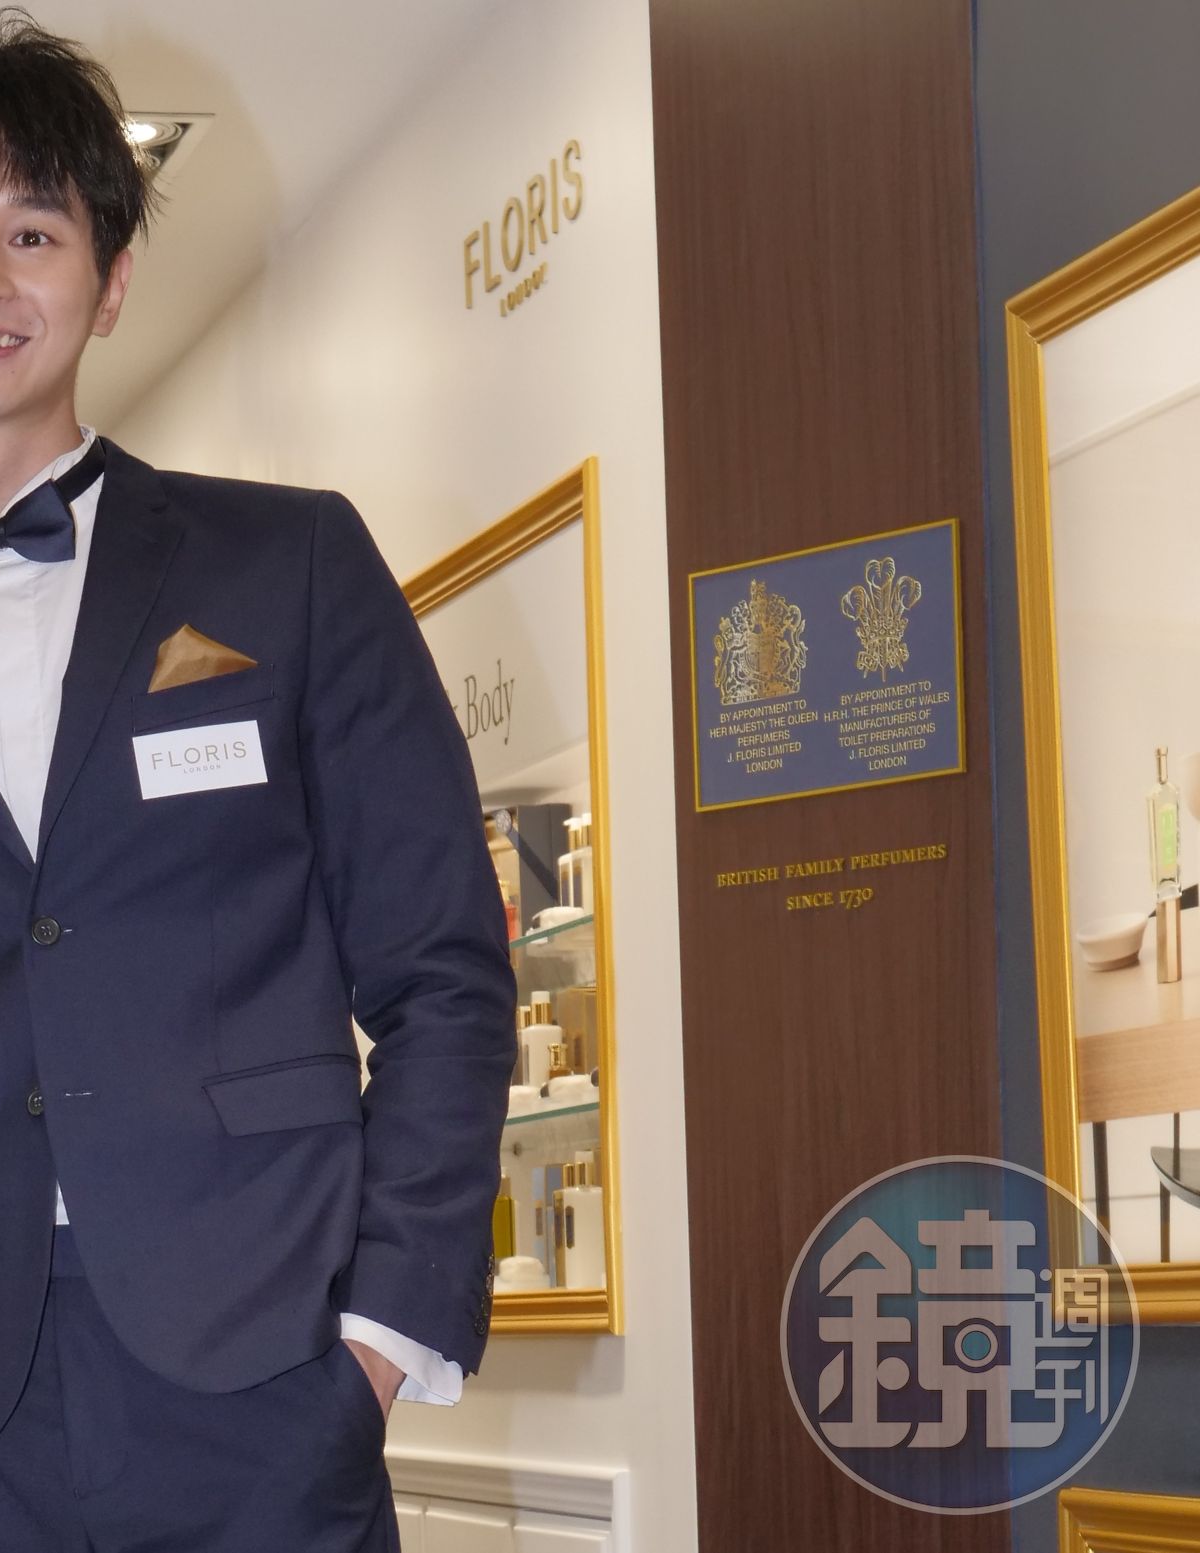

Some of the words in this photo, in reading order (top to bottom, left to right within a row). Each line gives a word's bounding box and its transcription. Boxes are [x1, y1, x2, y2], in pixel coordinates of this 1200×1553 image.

[464, 139, 584, 309] FLORIS
[464, 658, 515, 746] Body
[841, 695, 854, 705] BY
[854, 683, 917, 703] APPOINTMENT
[918, 680, 932, 692] TO
[720, 712, 731, 723] BY
[733, 702, 794, 721] APPOINTMENT
[794, 699, 807, 710] TO
[824, 711, 849, 723] H.R.H.
[852, 705, 869, 717] THE
[870, 699, 903, 714] PRINCE
[904, 697, 917, 709] OF
[918, 691, 950, 706] WALES
[709, 727, 728, 739] HER
[729, 719, 768, 735] MAJESTY
[768, 716, 786, 728] THE
[787, 712, 818, 726] QUEEN
[839, 711, 917, 733] MANUFACTURERS
[918, 709, 932, 721] OF
[737, 729, 791, 747] PERFUMERS
[838, 733, 869, 748] TOILET
[870, 722, 936, 742] PREPARATIONS
[151, 741, 247, 770] FLORIS
[727, 752, 734, 763] J.
[736, 747, 766, 761] FLORIS
[768, 741, 801, 756] LIMITED
[849, 749, 857, 760] J.
[858, 744, 890, 759] FLORIS
[891, 738, 926, 753] LIMITED
[746, 758, 783, 773] LONDON
[869, 755, 907, 771] LONDON
[716, 867, 780, 888] BRITISH
[784, 858, 846, 879] FAMILY
[850, 843, 948, 871] PERFUMERS
[786, 891, 834, 911] SINCE
[840, 887, 874, 909] 1730
